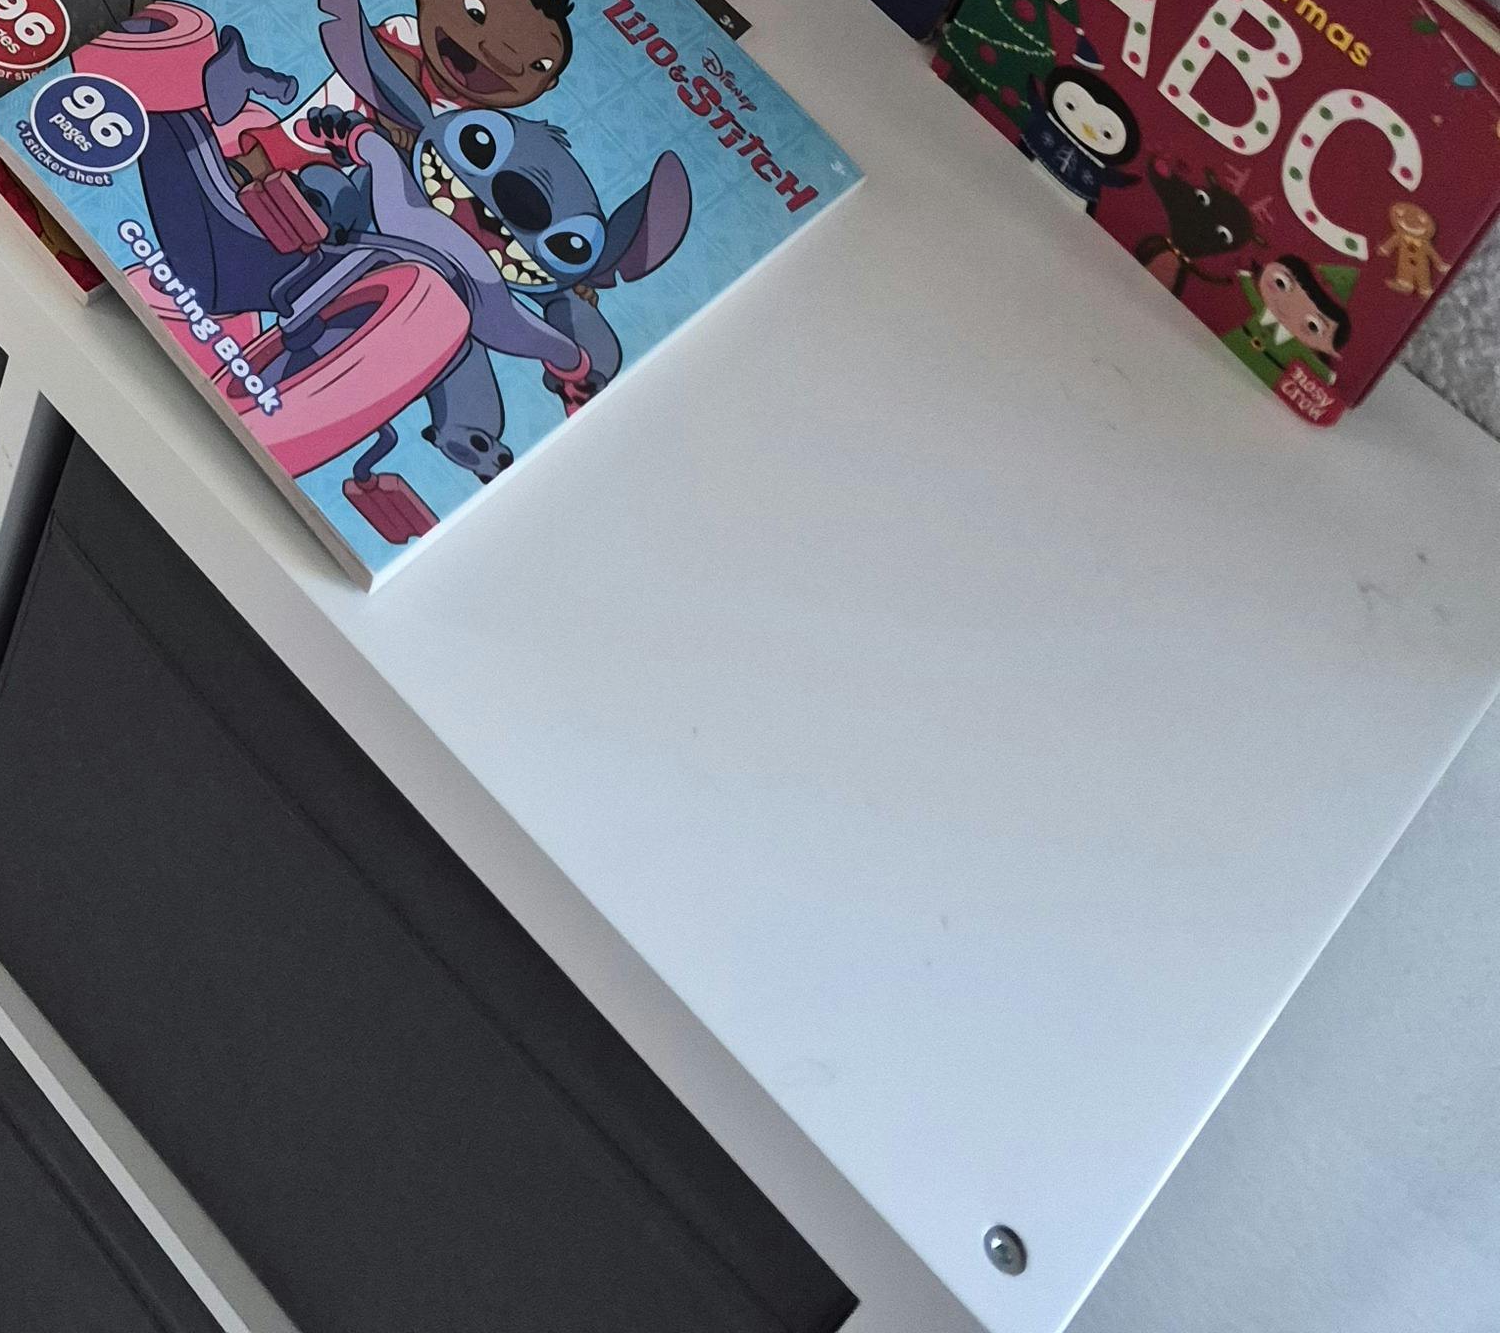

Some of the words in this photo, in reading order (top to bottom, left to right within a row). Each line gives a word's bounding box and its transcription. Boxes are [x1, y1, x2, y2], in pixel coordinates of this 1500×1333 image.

[47, 110, 92, 153] pages
[61, 84, 134, 151] 96
[22, 141, 66, 178] sticker
[68, 168, 112, 188] sheet
[116, 218, 221, 343] Coloring
[212, 335, 282, 415] Book
